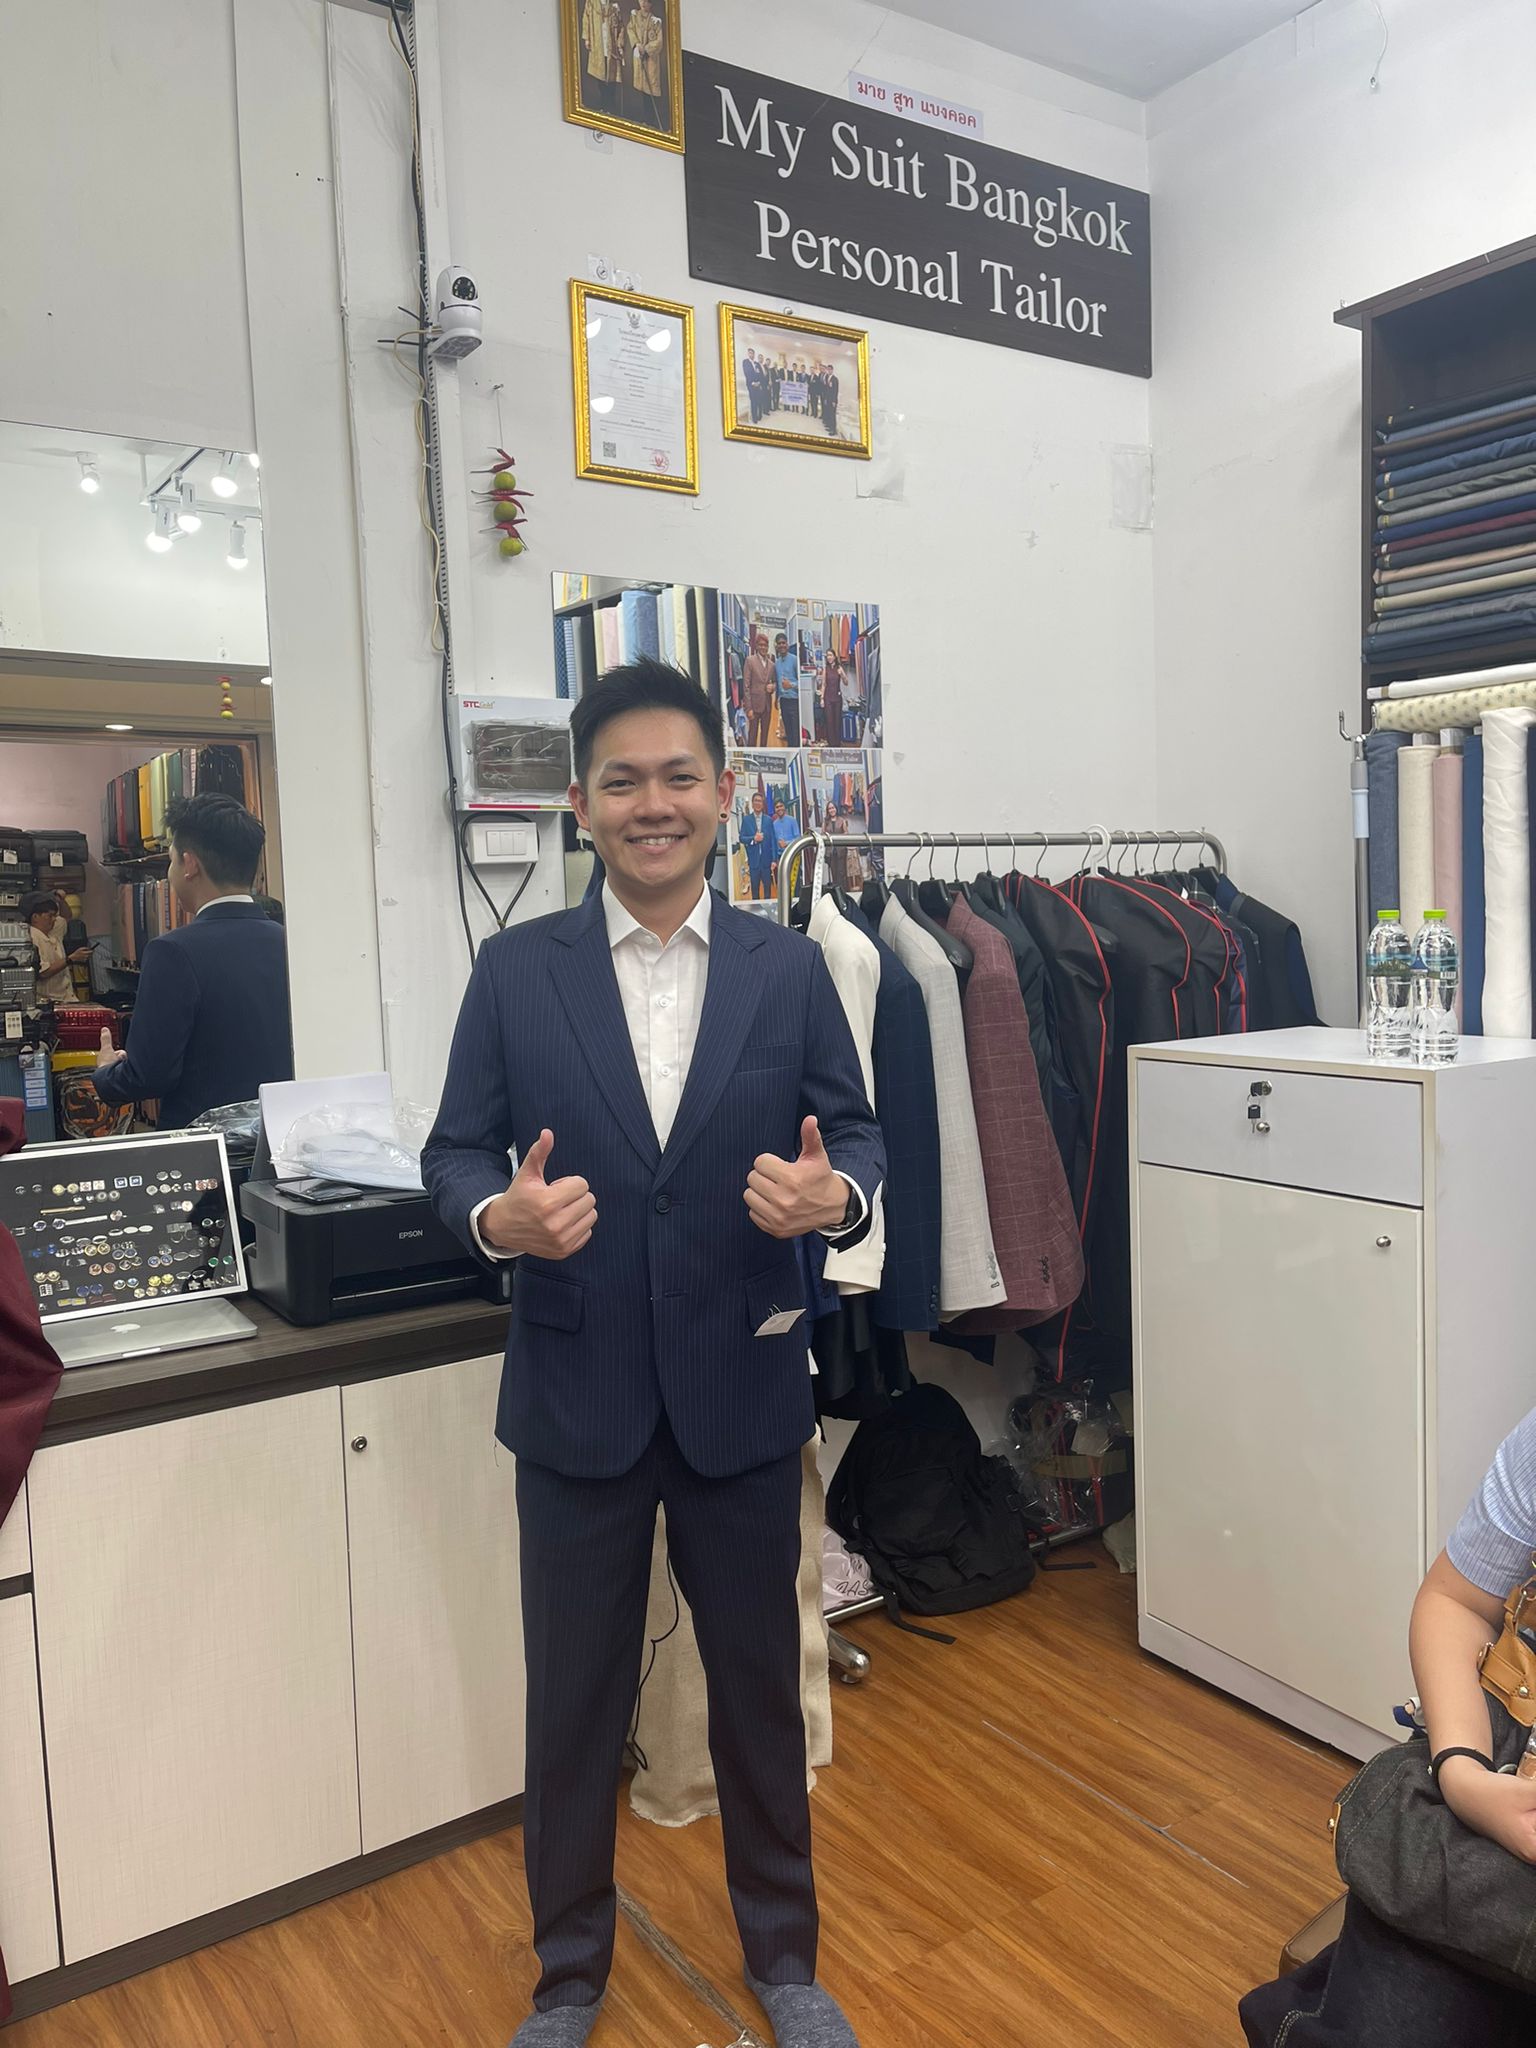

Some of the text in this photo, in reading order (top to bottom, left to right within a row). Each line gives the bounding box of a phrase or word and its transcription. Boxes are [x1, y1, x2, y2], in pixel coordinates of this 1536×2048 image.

[857, 81, 977, 129] มาย สูท แบงคอค
[714, 84, 1132, 256] My Suit Bangkok
[753, 200, 1107, 338] Personal Tailor
[398, 1229, 423, 1239] EPSON
